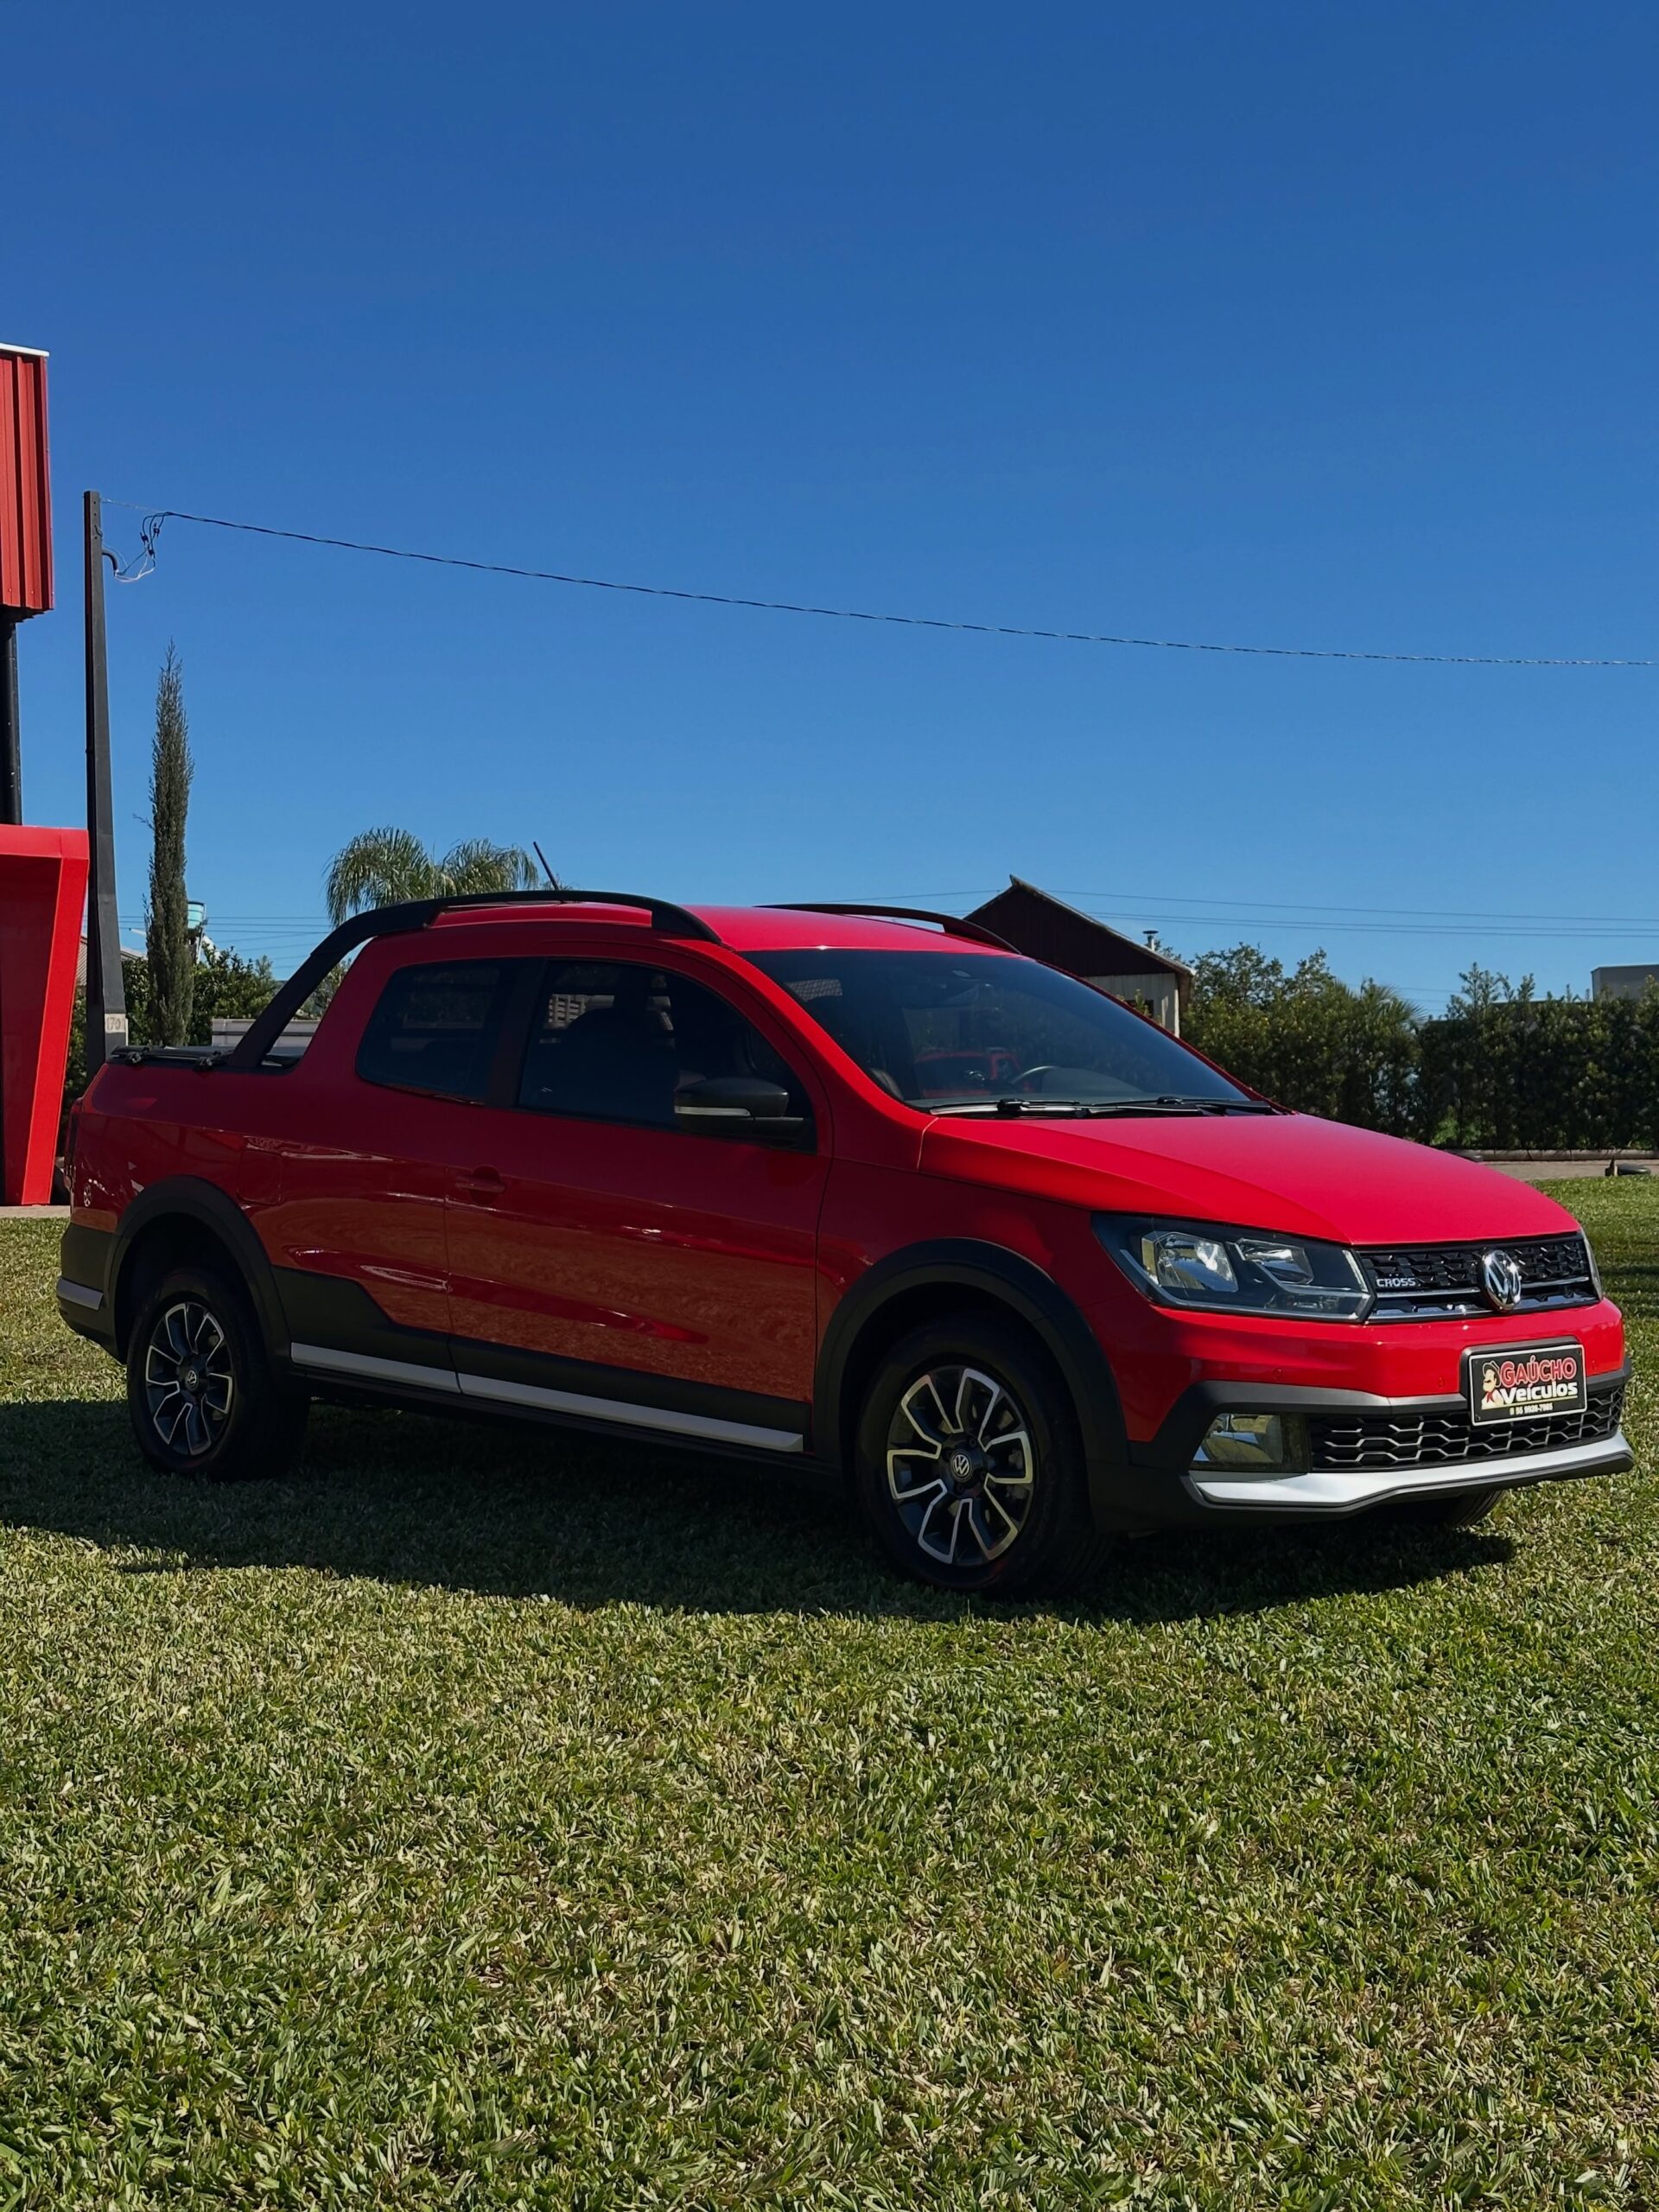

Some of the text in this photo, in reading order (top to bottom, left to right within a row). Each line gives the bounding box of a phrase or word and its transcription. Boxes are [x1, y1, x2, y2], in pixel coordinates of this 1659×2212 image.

[1376, 1277, 1416, 1287] CROSS
[1500, 1355, 1577, 1388] GAÚCHO
[1498, 1380, 1578, 1405] Veículos
